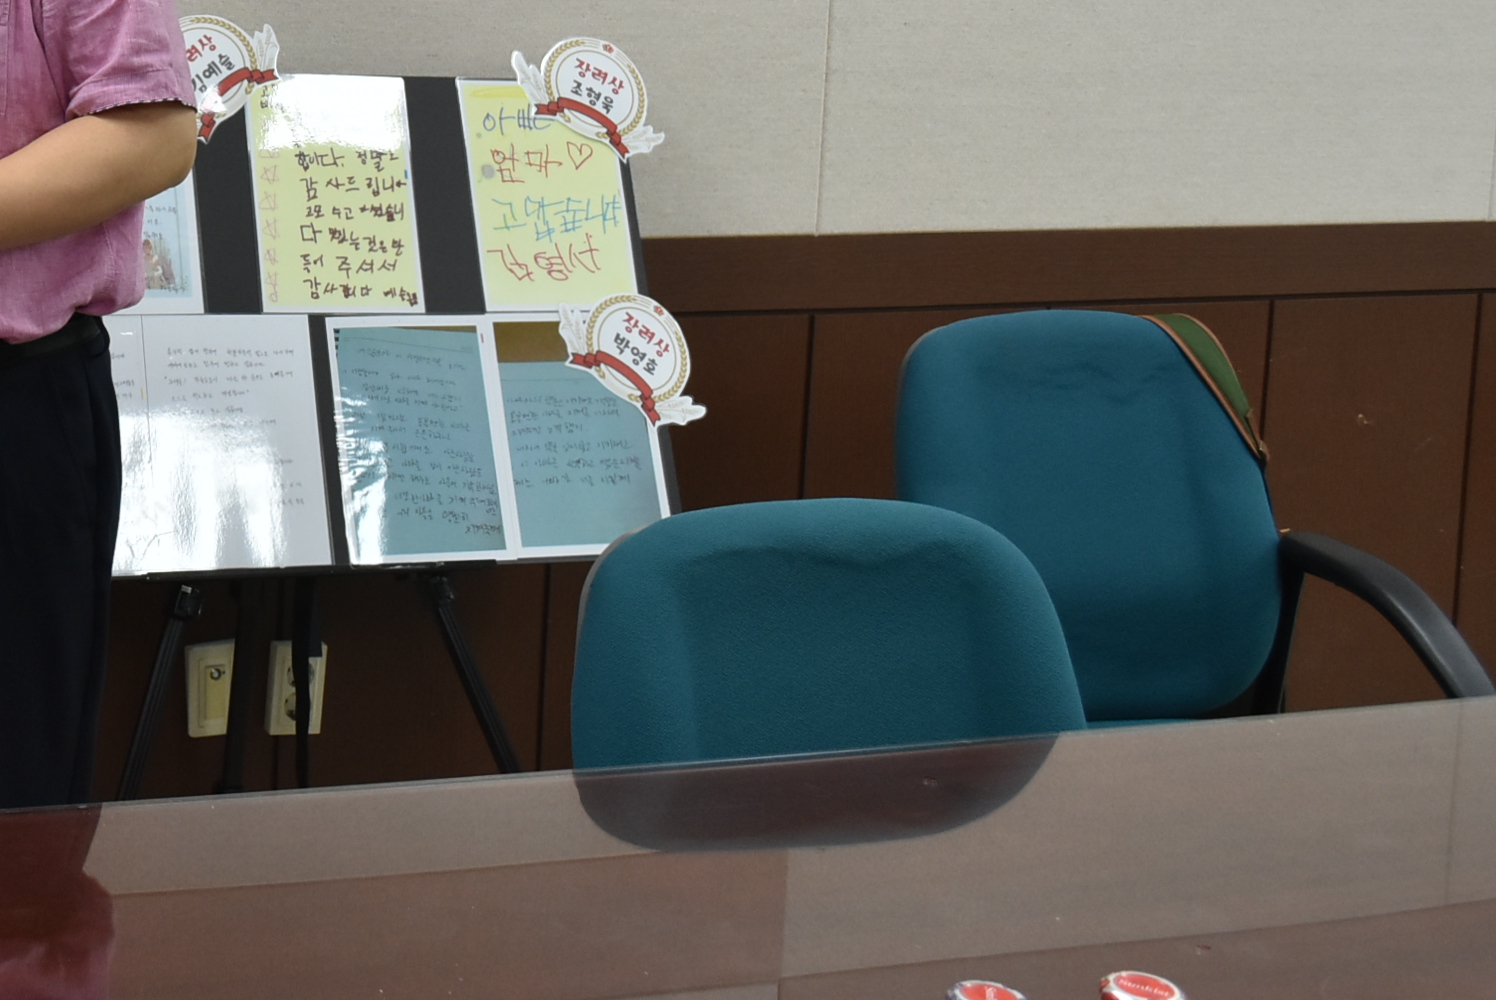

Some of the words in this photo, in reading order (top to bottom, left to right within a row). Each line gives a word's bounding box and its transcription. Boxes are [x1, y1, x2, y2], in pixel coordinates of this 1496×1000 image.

[186, 34, 217, 62] 려상
[574, 57, 625, 95] 장려상
[570, 79, 614, 115] 조형욱
[622, 311, 671, 358] 장려상
[613, 332, 659, 376] 박영호
